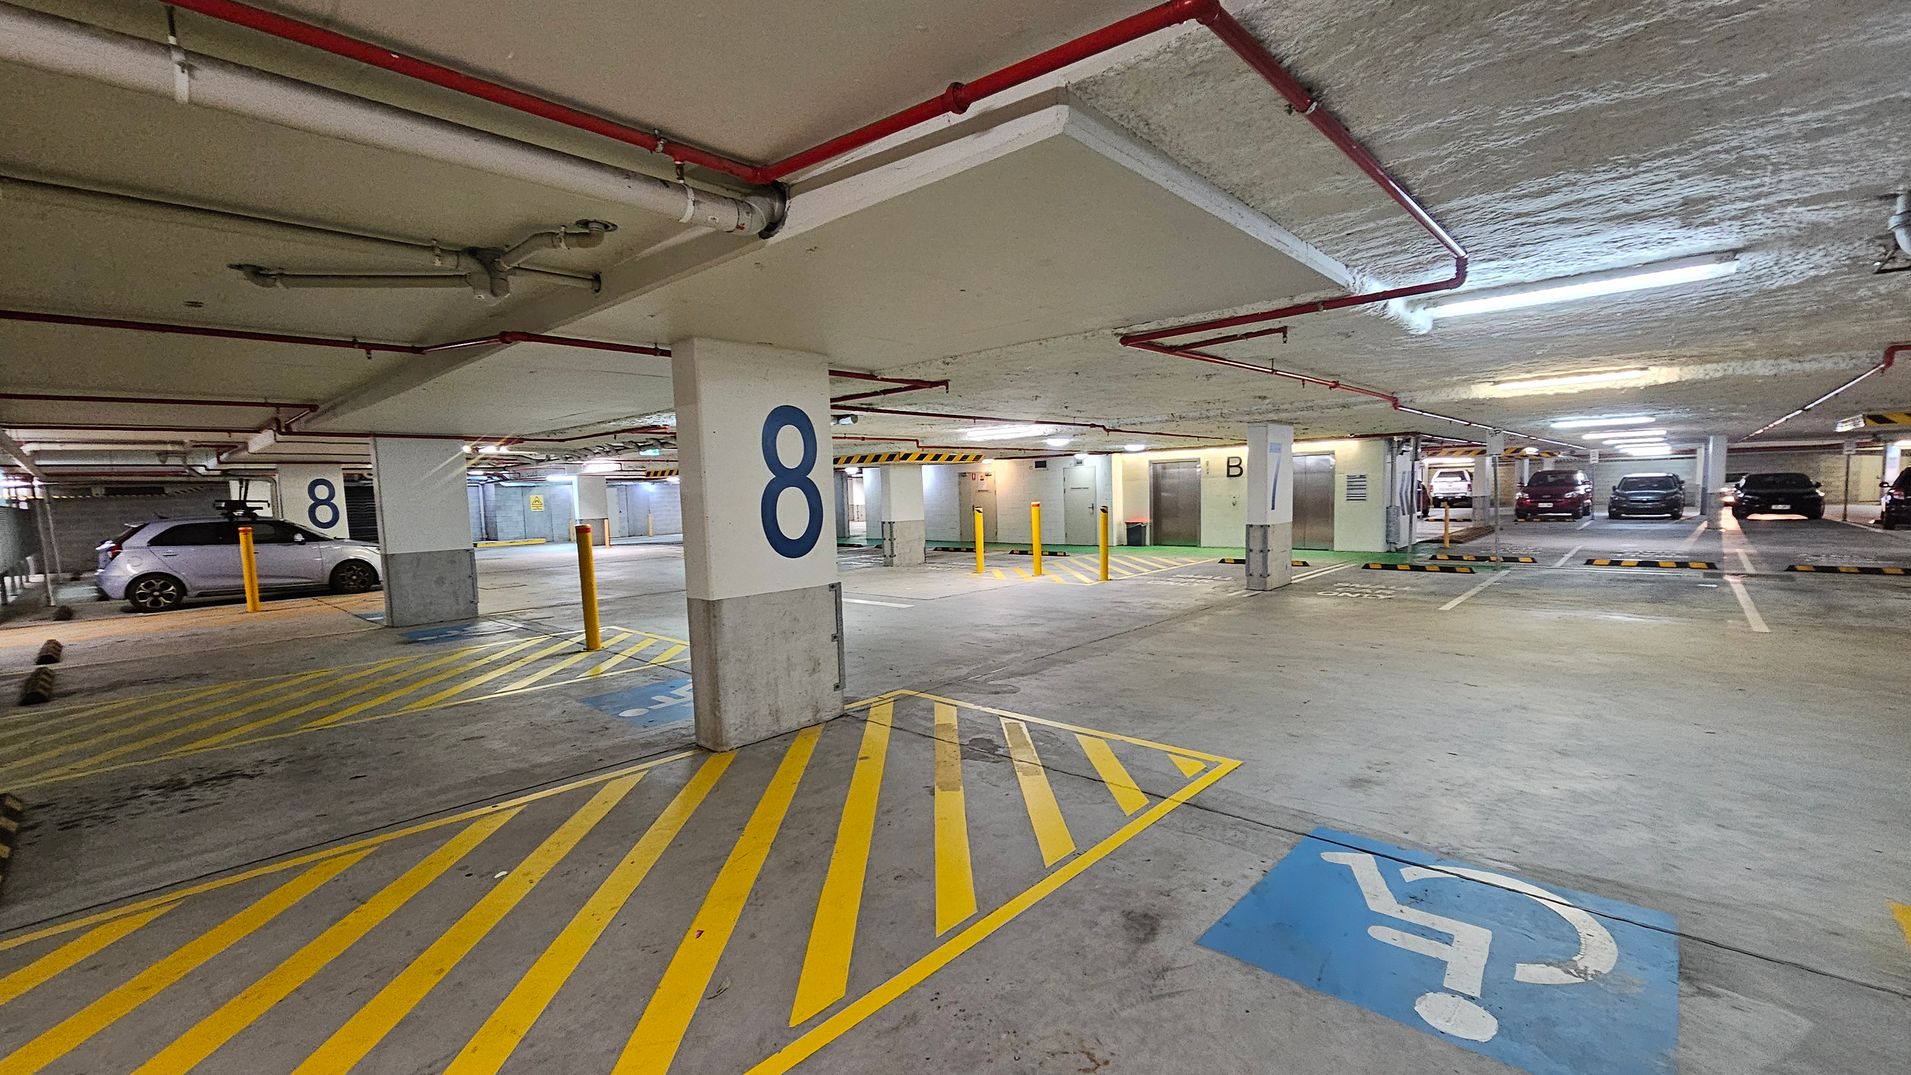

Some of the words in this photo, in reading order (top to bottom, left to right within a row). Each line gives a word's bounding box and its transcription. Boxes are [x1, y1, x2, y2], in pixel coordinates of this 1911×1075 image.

[761, 405, 824, 558] 8
[1226, 456, 1244, 477] B
[1269, 442, 1282, 510] 7
[307, 478, 340, 529] 8
